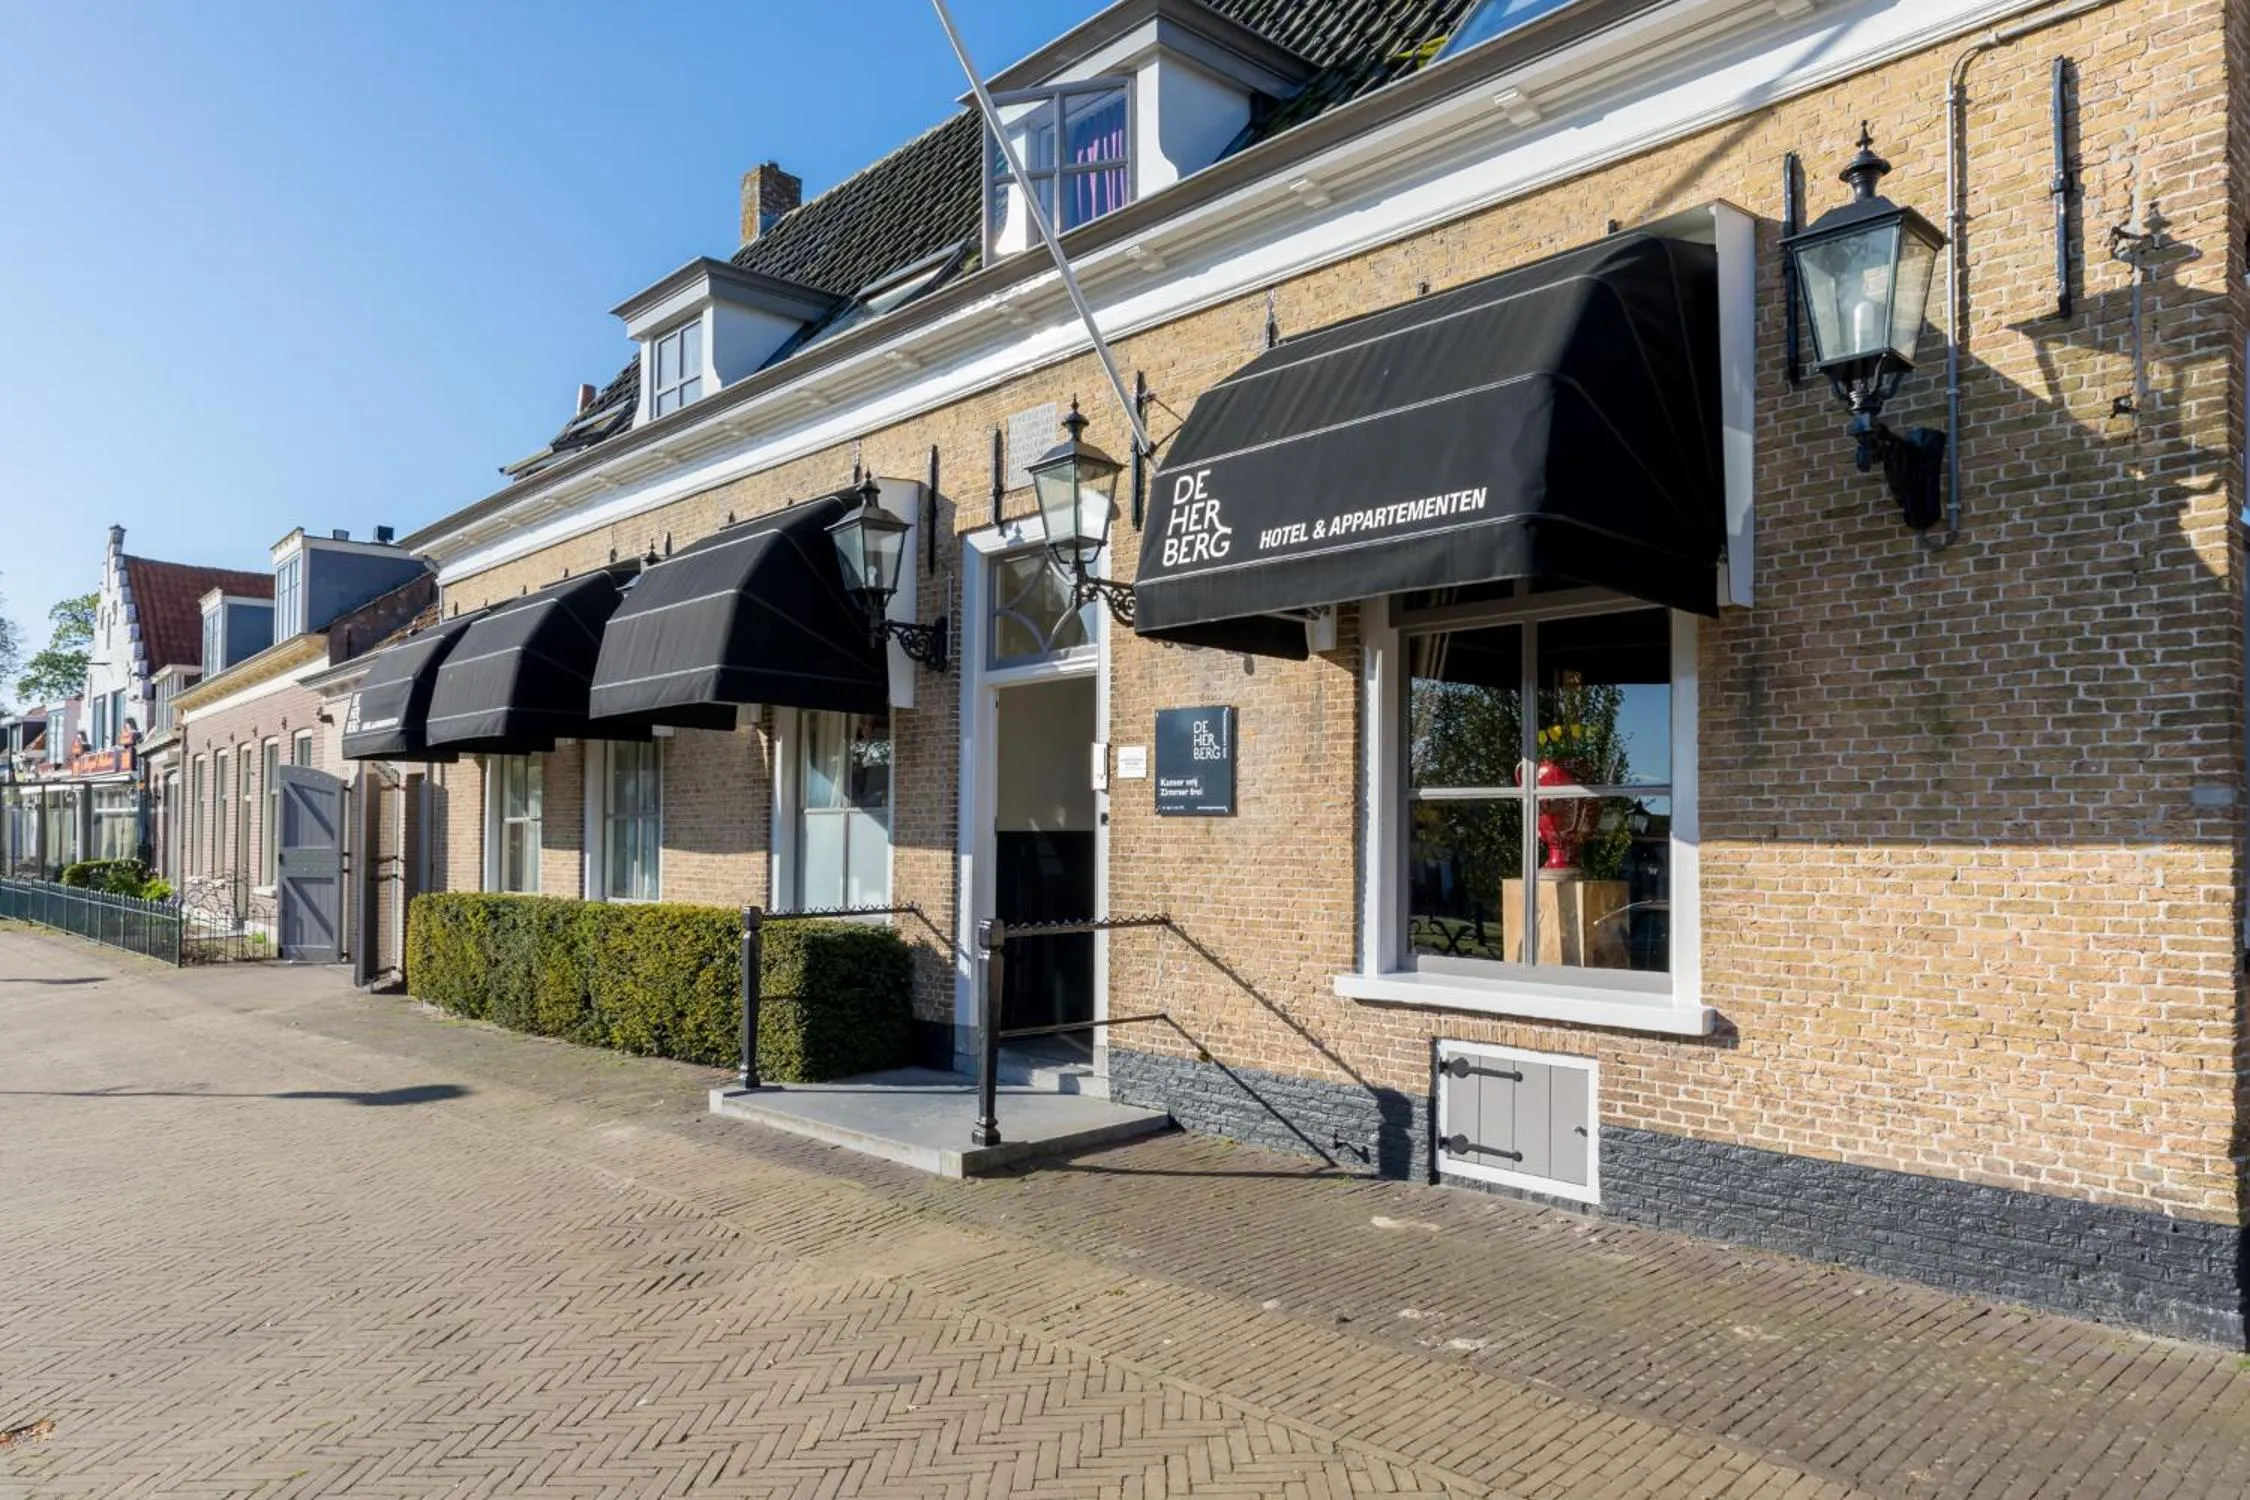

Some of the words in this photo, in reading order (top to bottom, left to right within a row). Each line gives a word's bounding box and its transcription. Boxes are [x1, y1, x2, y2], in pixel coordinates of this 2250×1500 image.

[1173, 469, 1211, 504] DE
[1167, 498, 1227, 536] HER
[1259, 527, 1309, 549] HOTEL
[1312, 520, 1326, 538] &
[1329, 487, 1487, 537] APPARTEMENTEN
[1162, 528, 1232, 567] BERG
[1193, 720, 1209, 734] DE
[1193, 733, 1215, 746] HER
[1193, 746, 1221, 760] BERG
